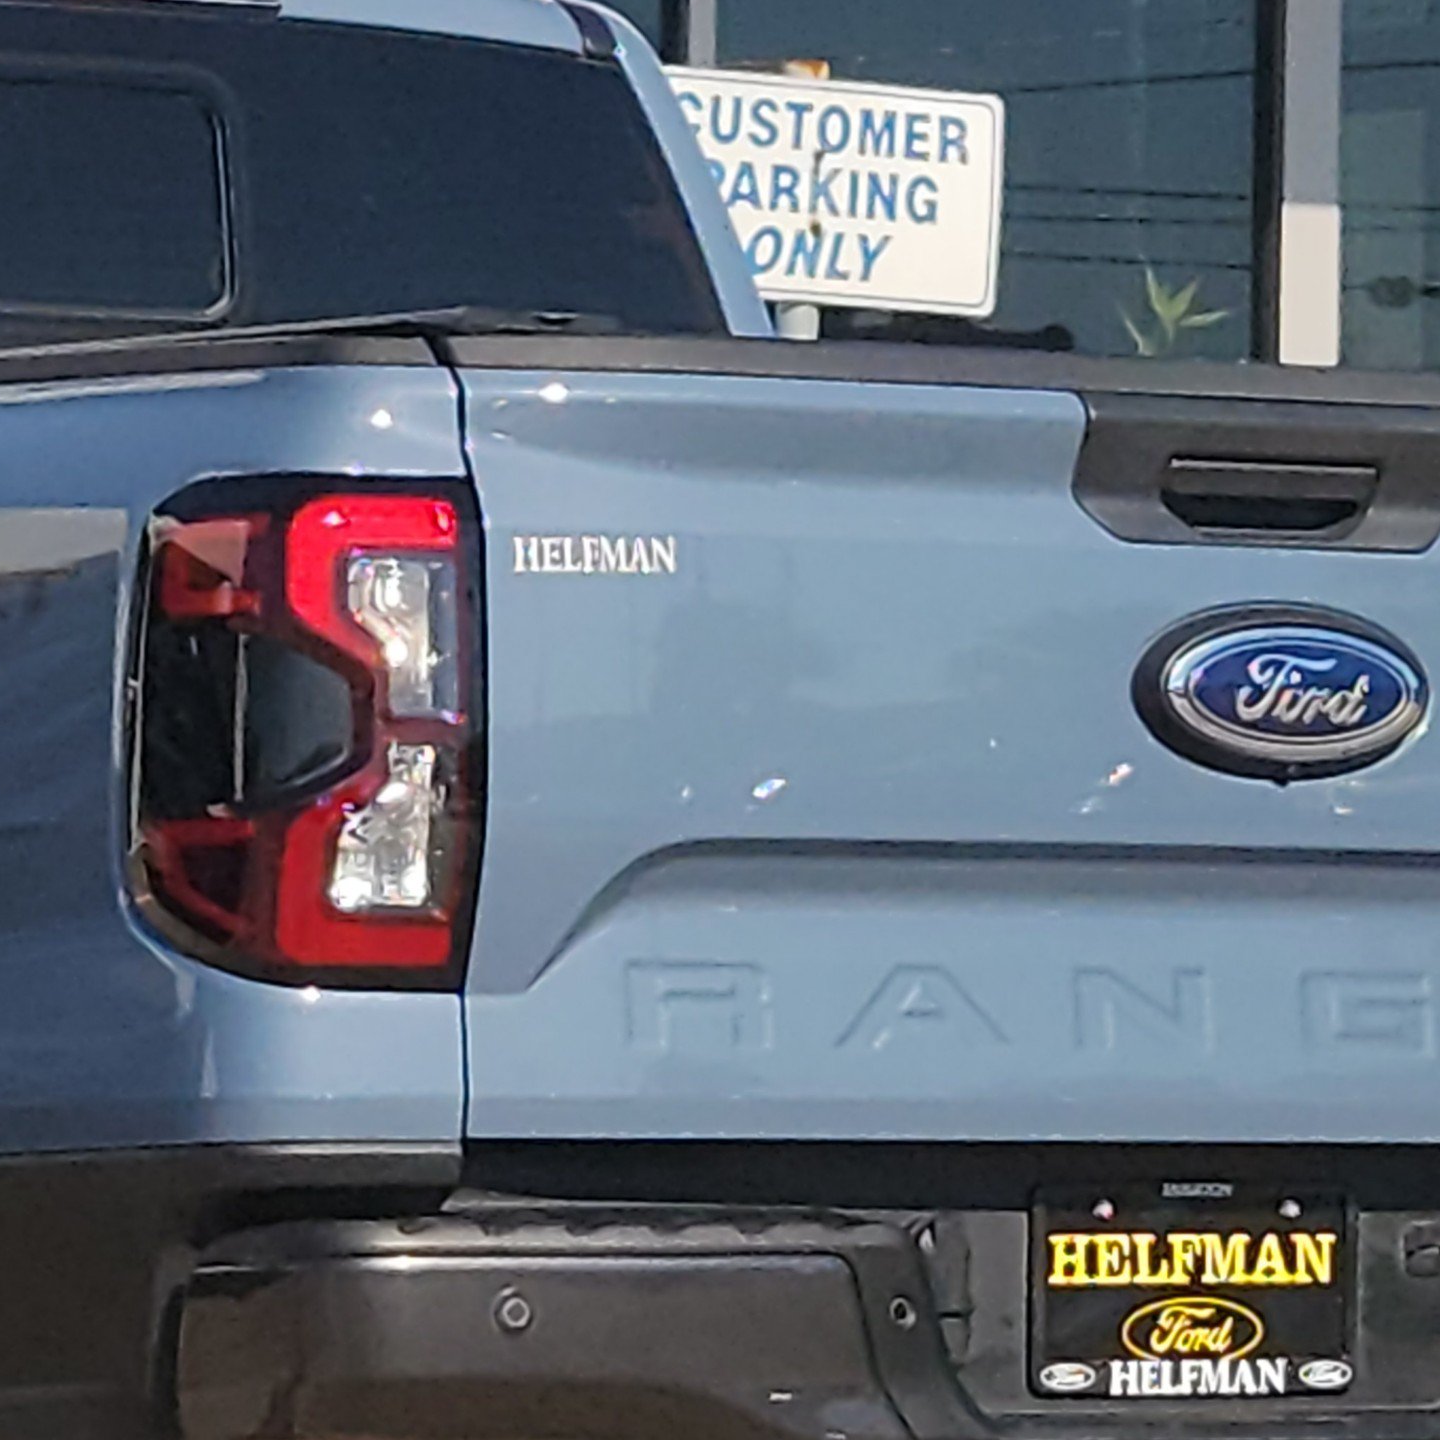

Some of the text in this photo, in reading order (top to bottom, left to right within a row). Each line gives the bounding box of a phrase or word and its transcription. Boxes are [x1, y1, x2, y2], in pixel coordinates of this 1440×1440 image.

[746, 224, 893, 284] ONLY
[512, 533, 678, 576] HELFMAN
[1234, 652, 1372, 727] Ford
[1046, 1231, 1338, 1288] HELFMAN
[1148, 1303, 1236, 1354] Ford
[1107, 1356, 1290, 1398] HELFMAN
